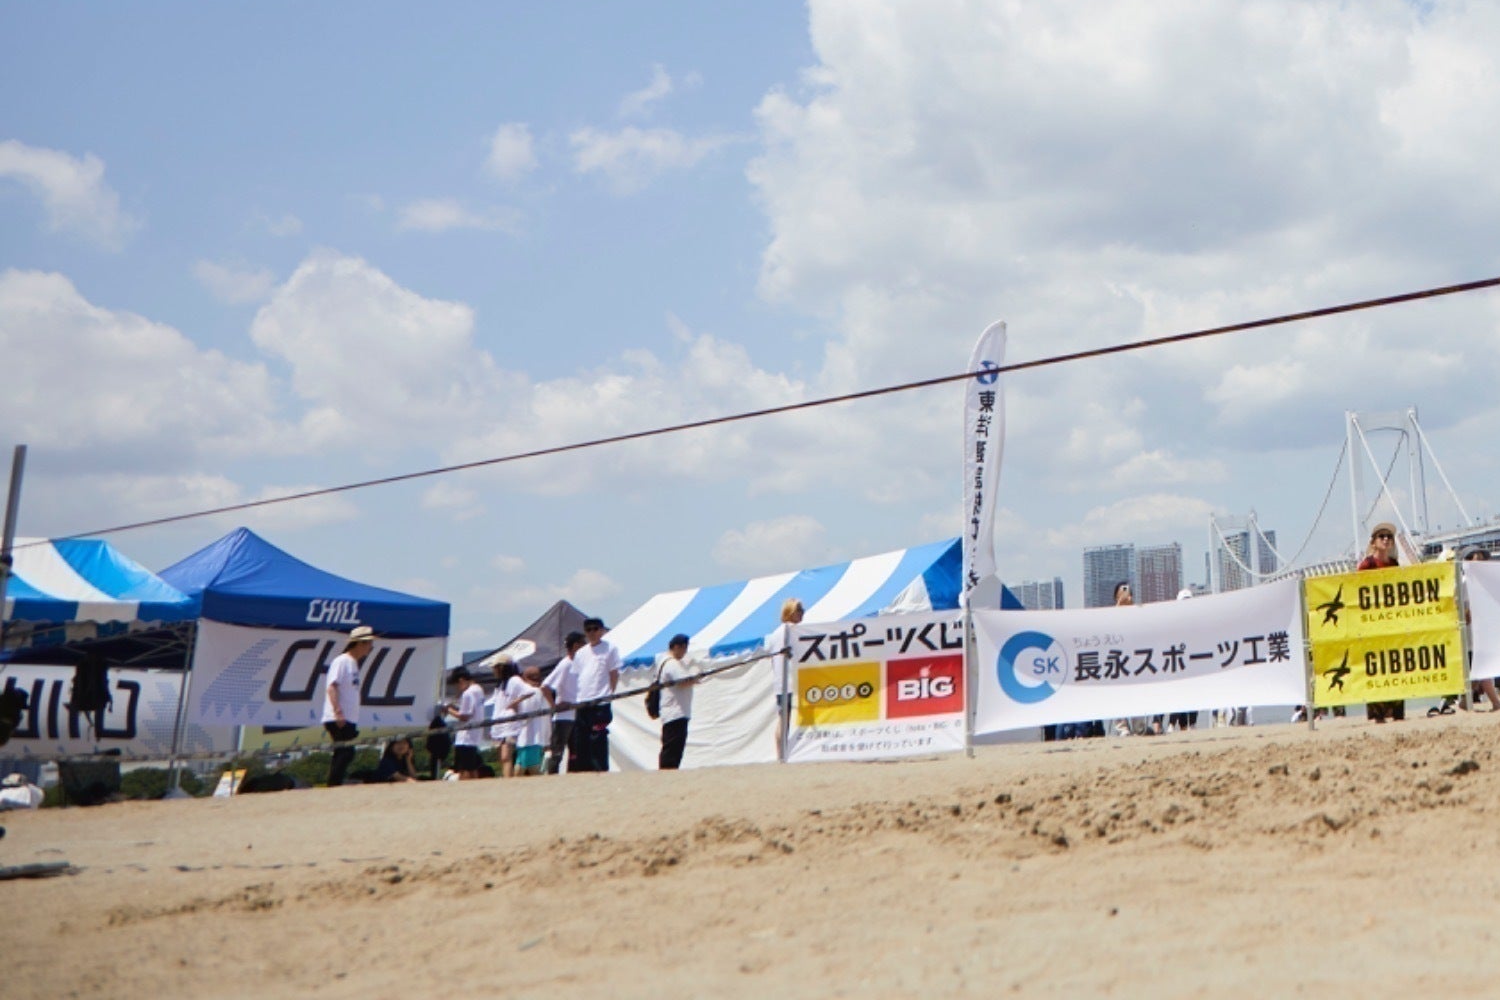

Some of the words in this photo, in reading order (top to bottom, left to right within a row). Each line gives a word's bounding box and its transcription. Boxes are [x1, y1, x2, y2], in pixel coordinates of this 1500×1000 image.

[1358, 578, 1440, 611] GIBBON
[306, 599, 361, 624] CHILL
[1360, 604, 1442, 623] SLACKLINES
[798, 621, 963, 663] スポーツくじ
[1074, 630, 1291, 682] 長永スポーツ工業
[269, 638, 417, 706] CHLL
[1364, 643, 1446, 676] GIBBON
[806, 682, 873, 703] toto
[1365, 673, 1448, 689] SLACKLINES
